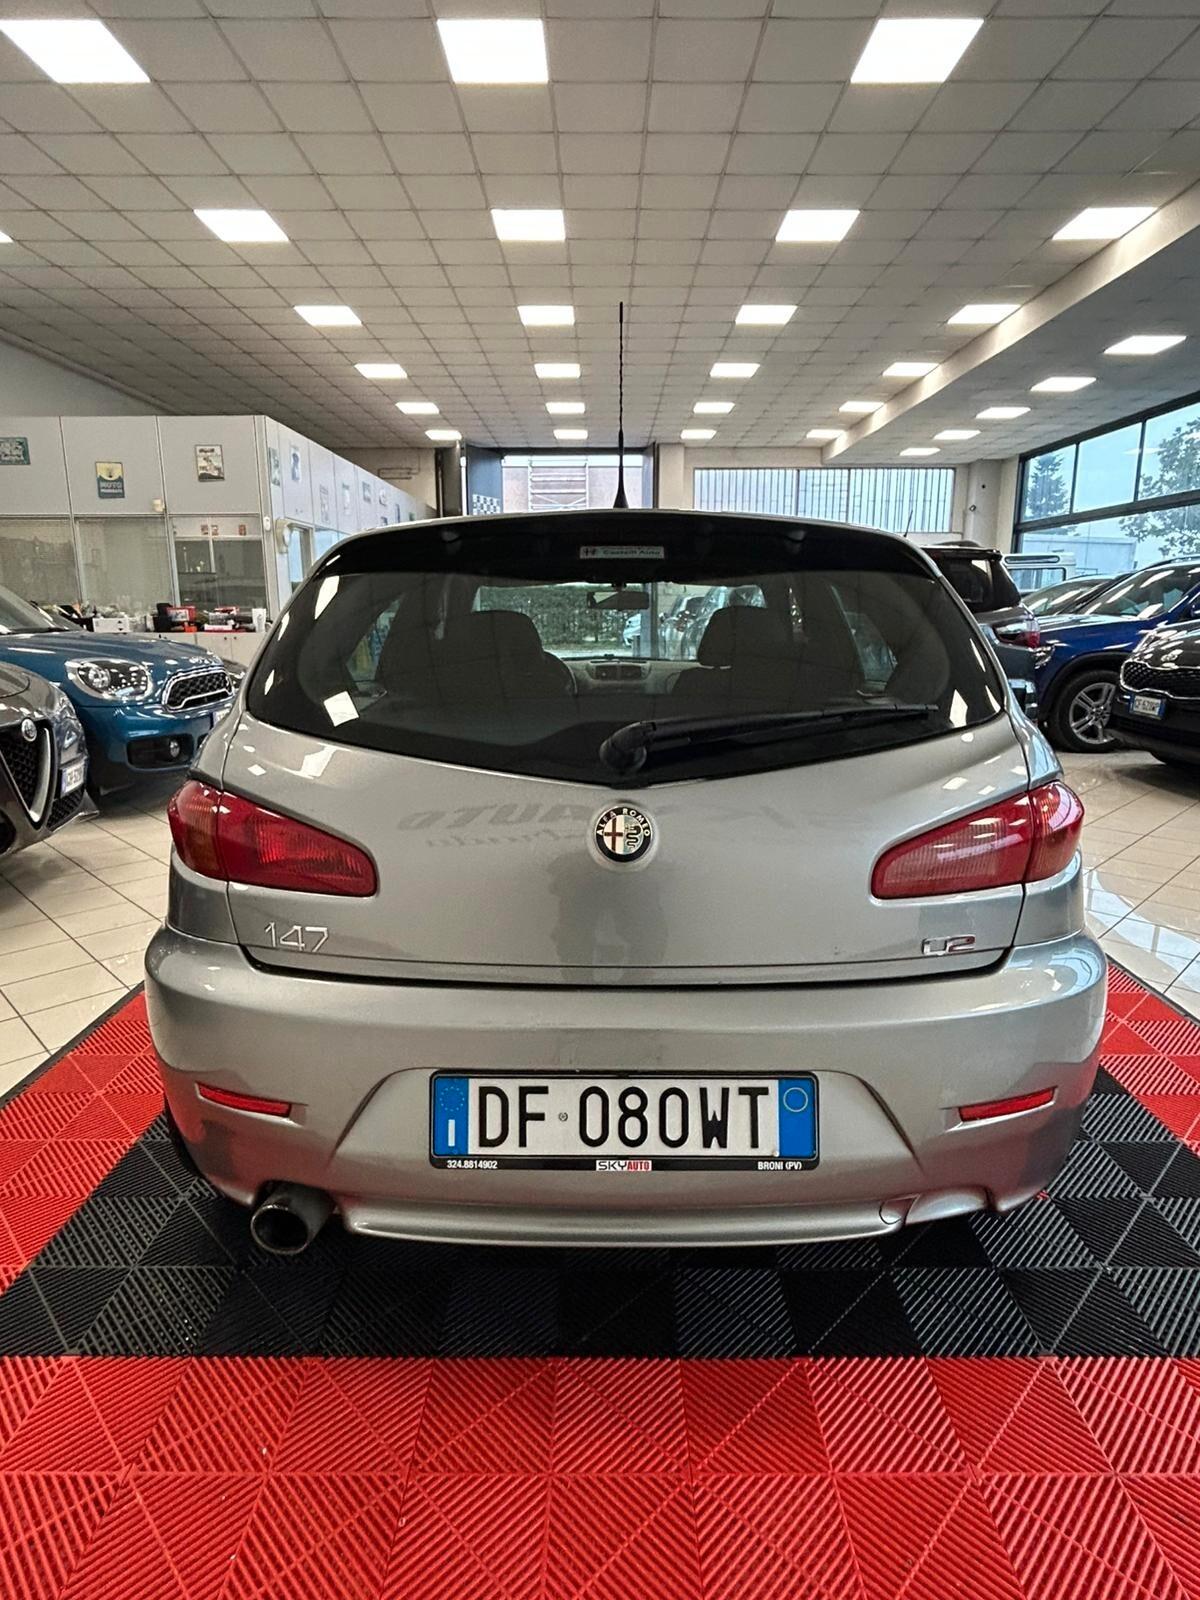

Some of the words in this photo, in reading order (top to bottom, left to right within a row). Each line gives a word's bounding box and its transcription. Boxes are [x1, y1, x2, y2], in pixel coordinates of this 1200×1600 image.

[596, 810, 617, 836] ALFA
[622, 808, 651, 837] ROMEO
[265, 922, 328, 952] 147
[478, 1085, 549, 1148] DF
[578, 1086, 769, 1149] 080WT
[446, 1160, 498, 1170] 324.8814902
[757, 1161, 783, 1171] BRONI
[785, 1161, 802, 1171] (PV)
